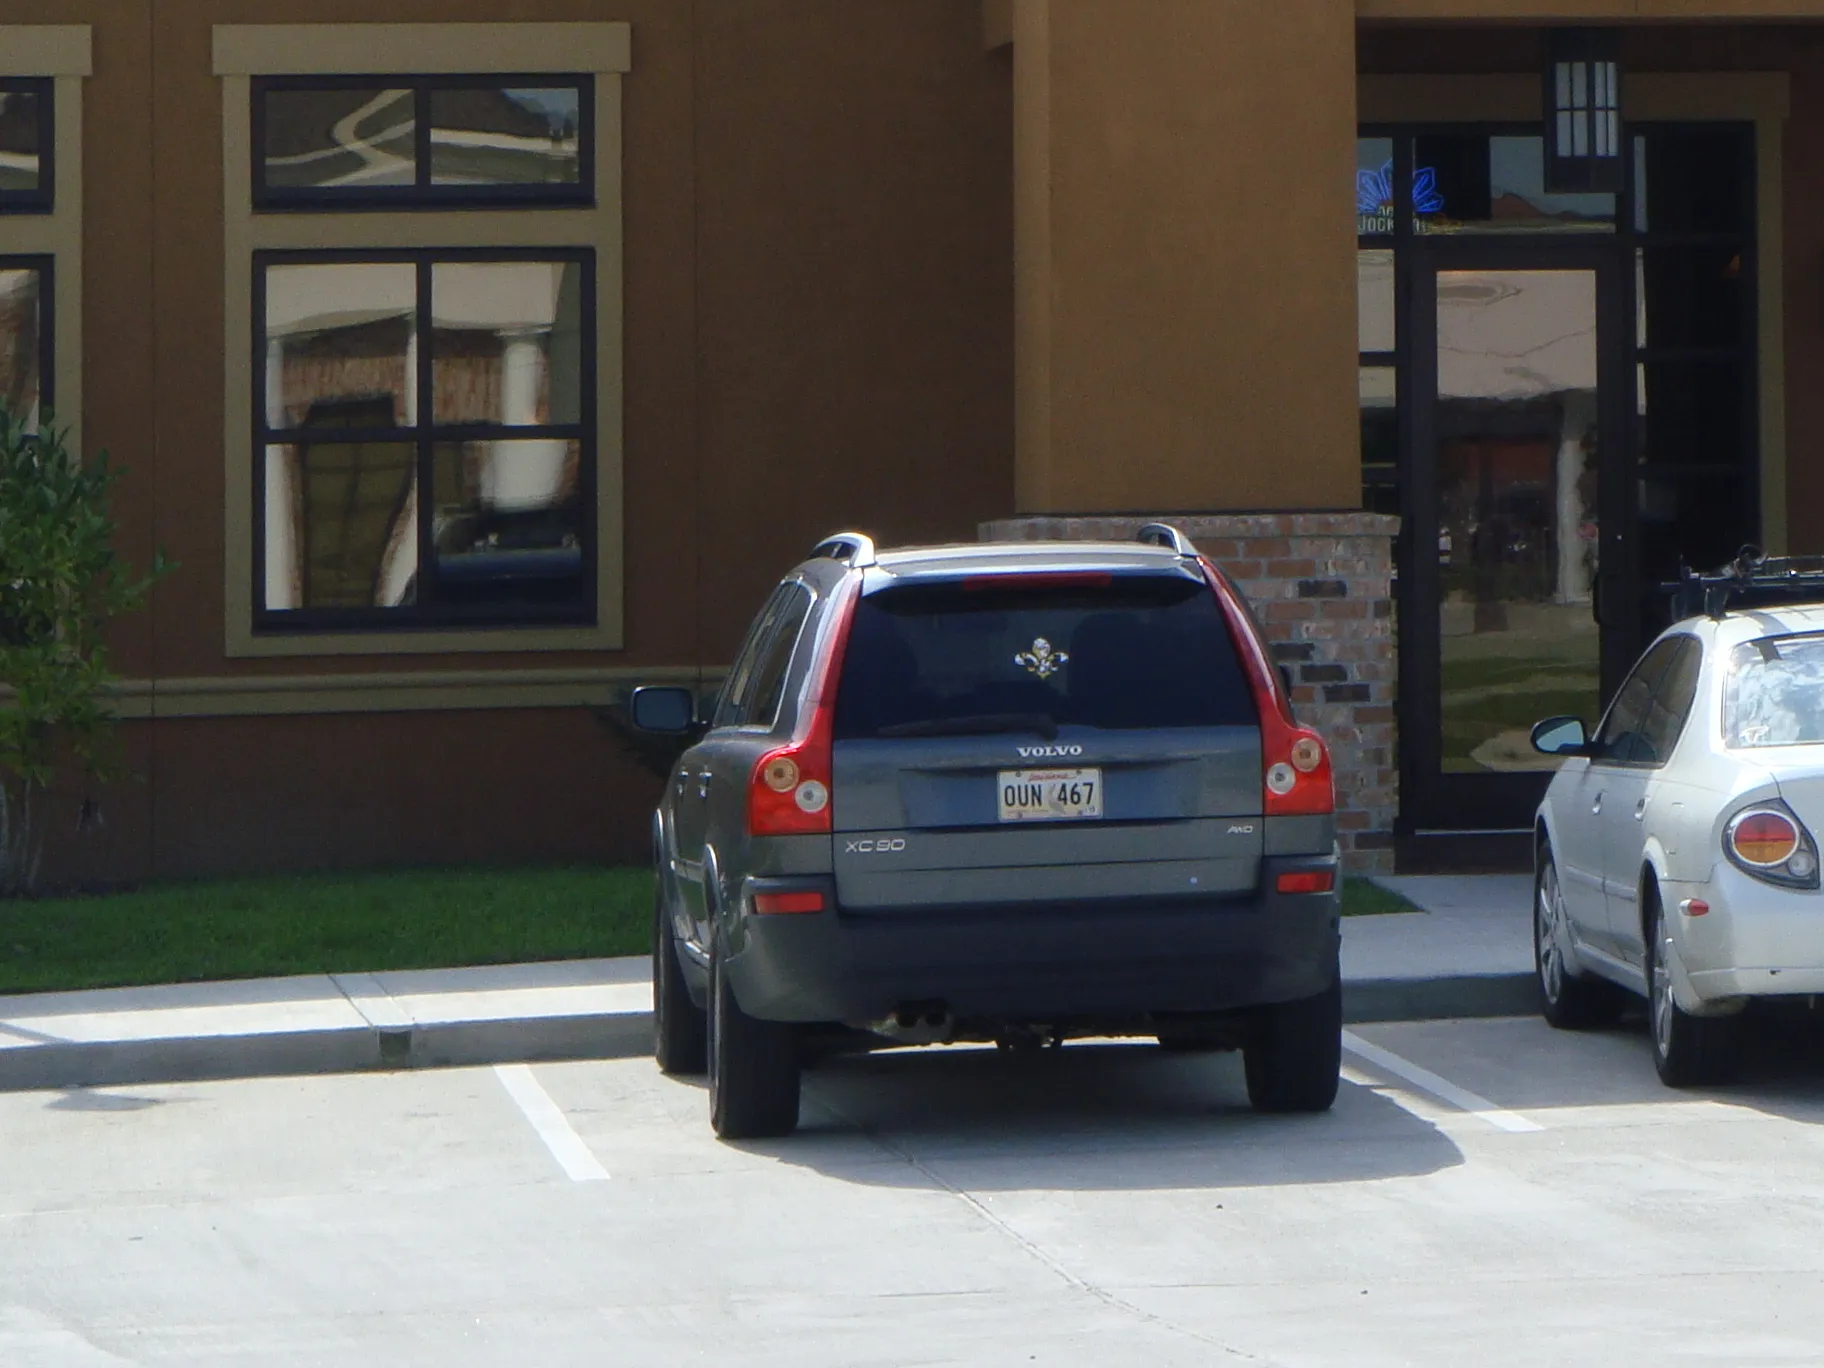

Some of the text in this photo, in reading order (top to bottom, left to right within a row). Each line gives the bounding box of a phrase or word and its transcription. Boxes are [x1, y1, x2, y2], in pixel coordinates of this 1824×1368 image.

[1016, 744, 1082, 757] VOLVO
[1004, 782, 1094, 807] OUN 467
